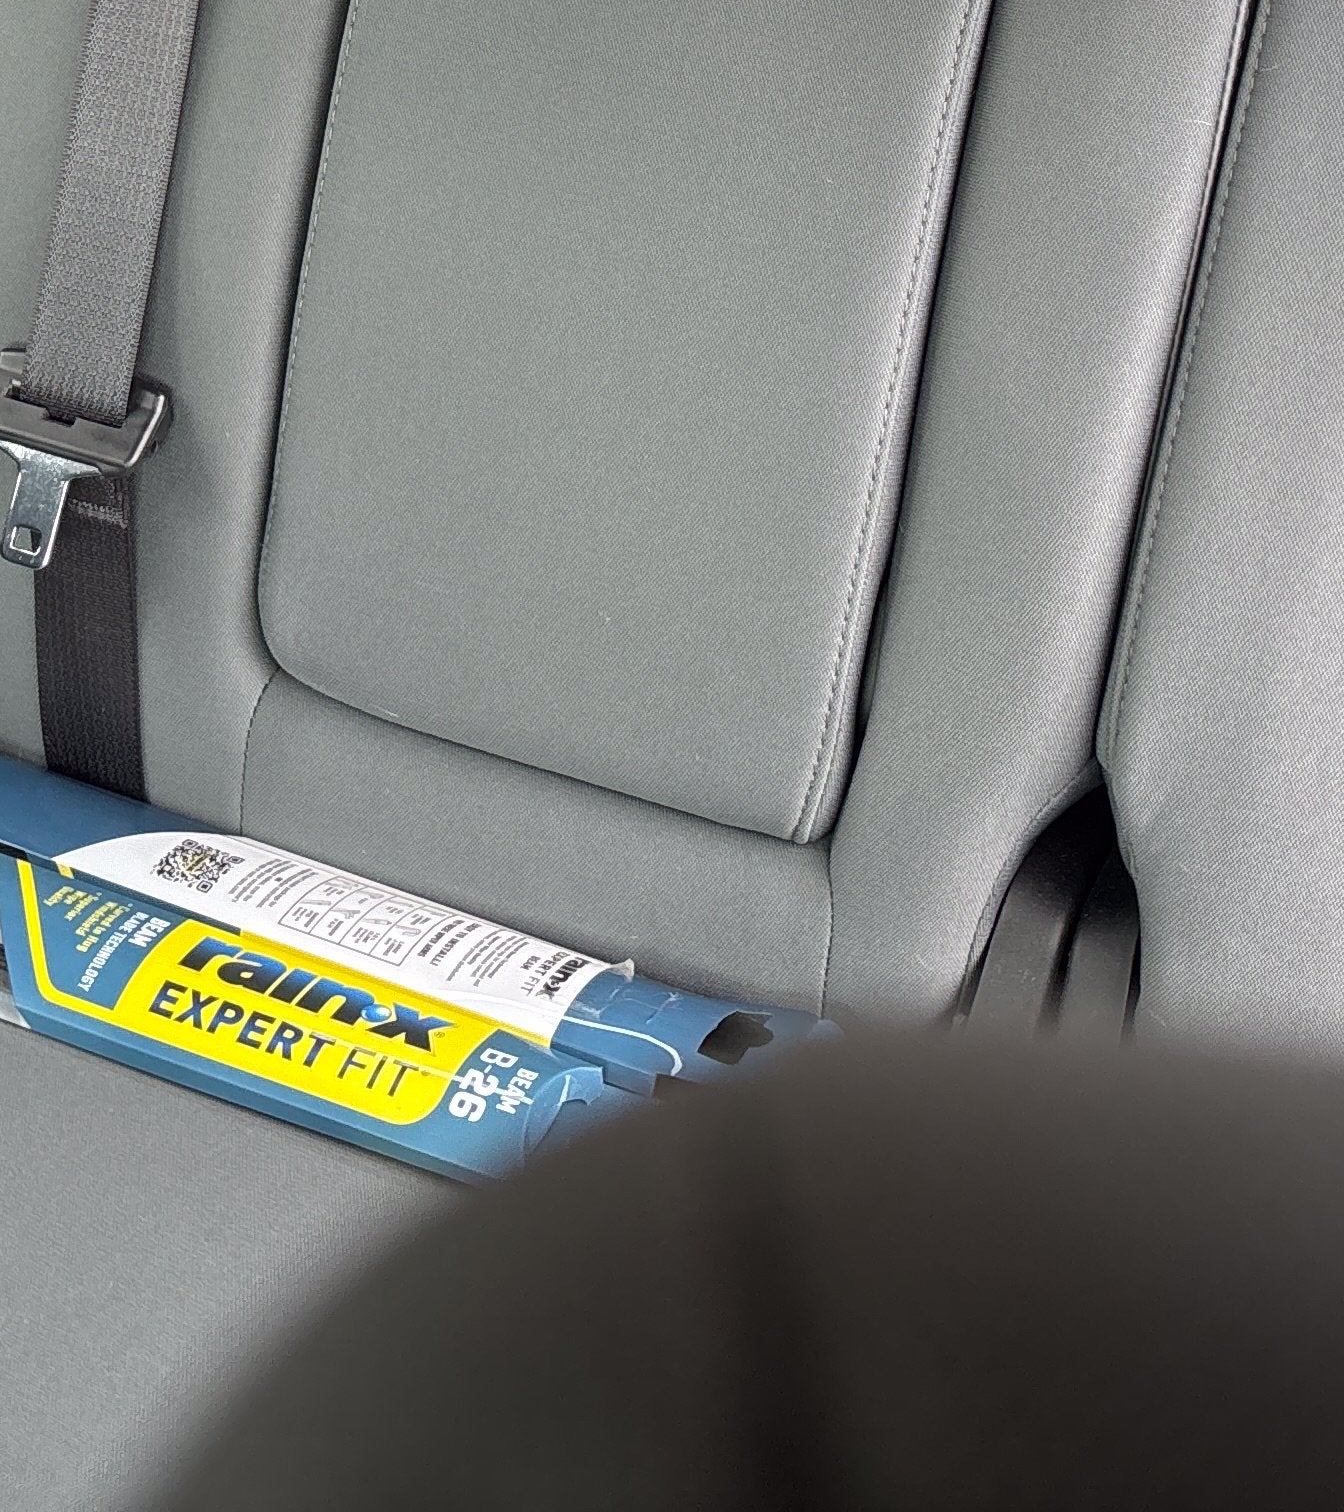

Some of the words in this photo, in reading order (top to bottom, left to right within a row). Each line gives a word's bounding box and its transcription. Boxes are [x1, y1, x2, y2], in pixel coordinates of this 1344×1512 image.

[119, 911, 149, 933] BLADE
[128, 917, 171, 947] BEAM
[77, 931, 127, 992] TECHNOLOGY
[539, 951, 570, 975] EXPERT
[520, 975, 540, 995] FIT
[148, 980, 336, 1068] EXPERT
[337, 1047, 419, 1097] FIT
[448, 1048, 519, 1122] B-26
[495, 1068, 540, 1114] BEAM
